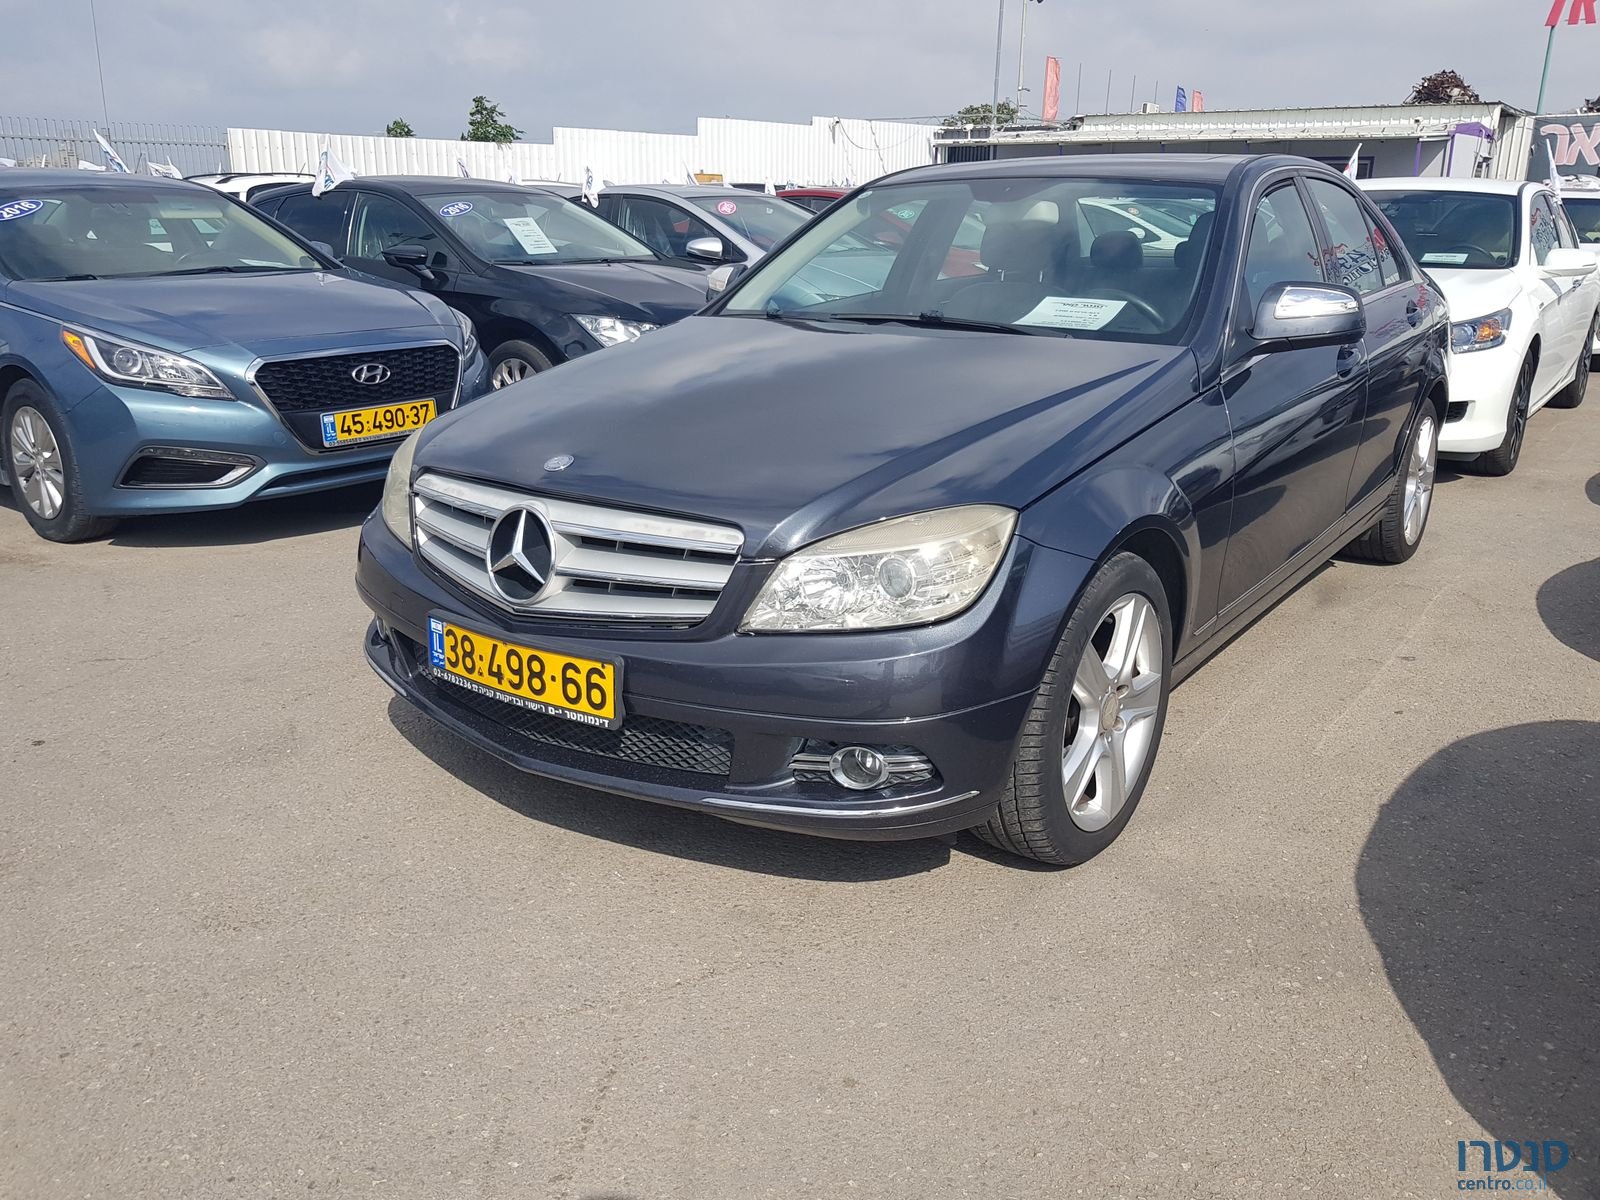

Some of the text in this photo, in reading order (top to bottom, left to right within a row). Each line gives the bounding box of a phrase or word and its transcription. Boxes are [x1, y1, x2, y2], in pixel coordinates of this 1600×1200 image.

[496, 692, 524, 707] ובדיקות
[526, 700, 546, 712] רישוי
[564, 710, 610, 728] דינמומטר
